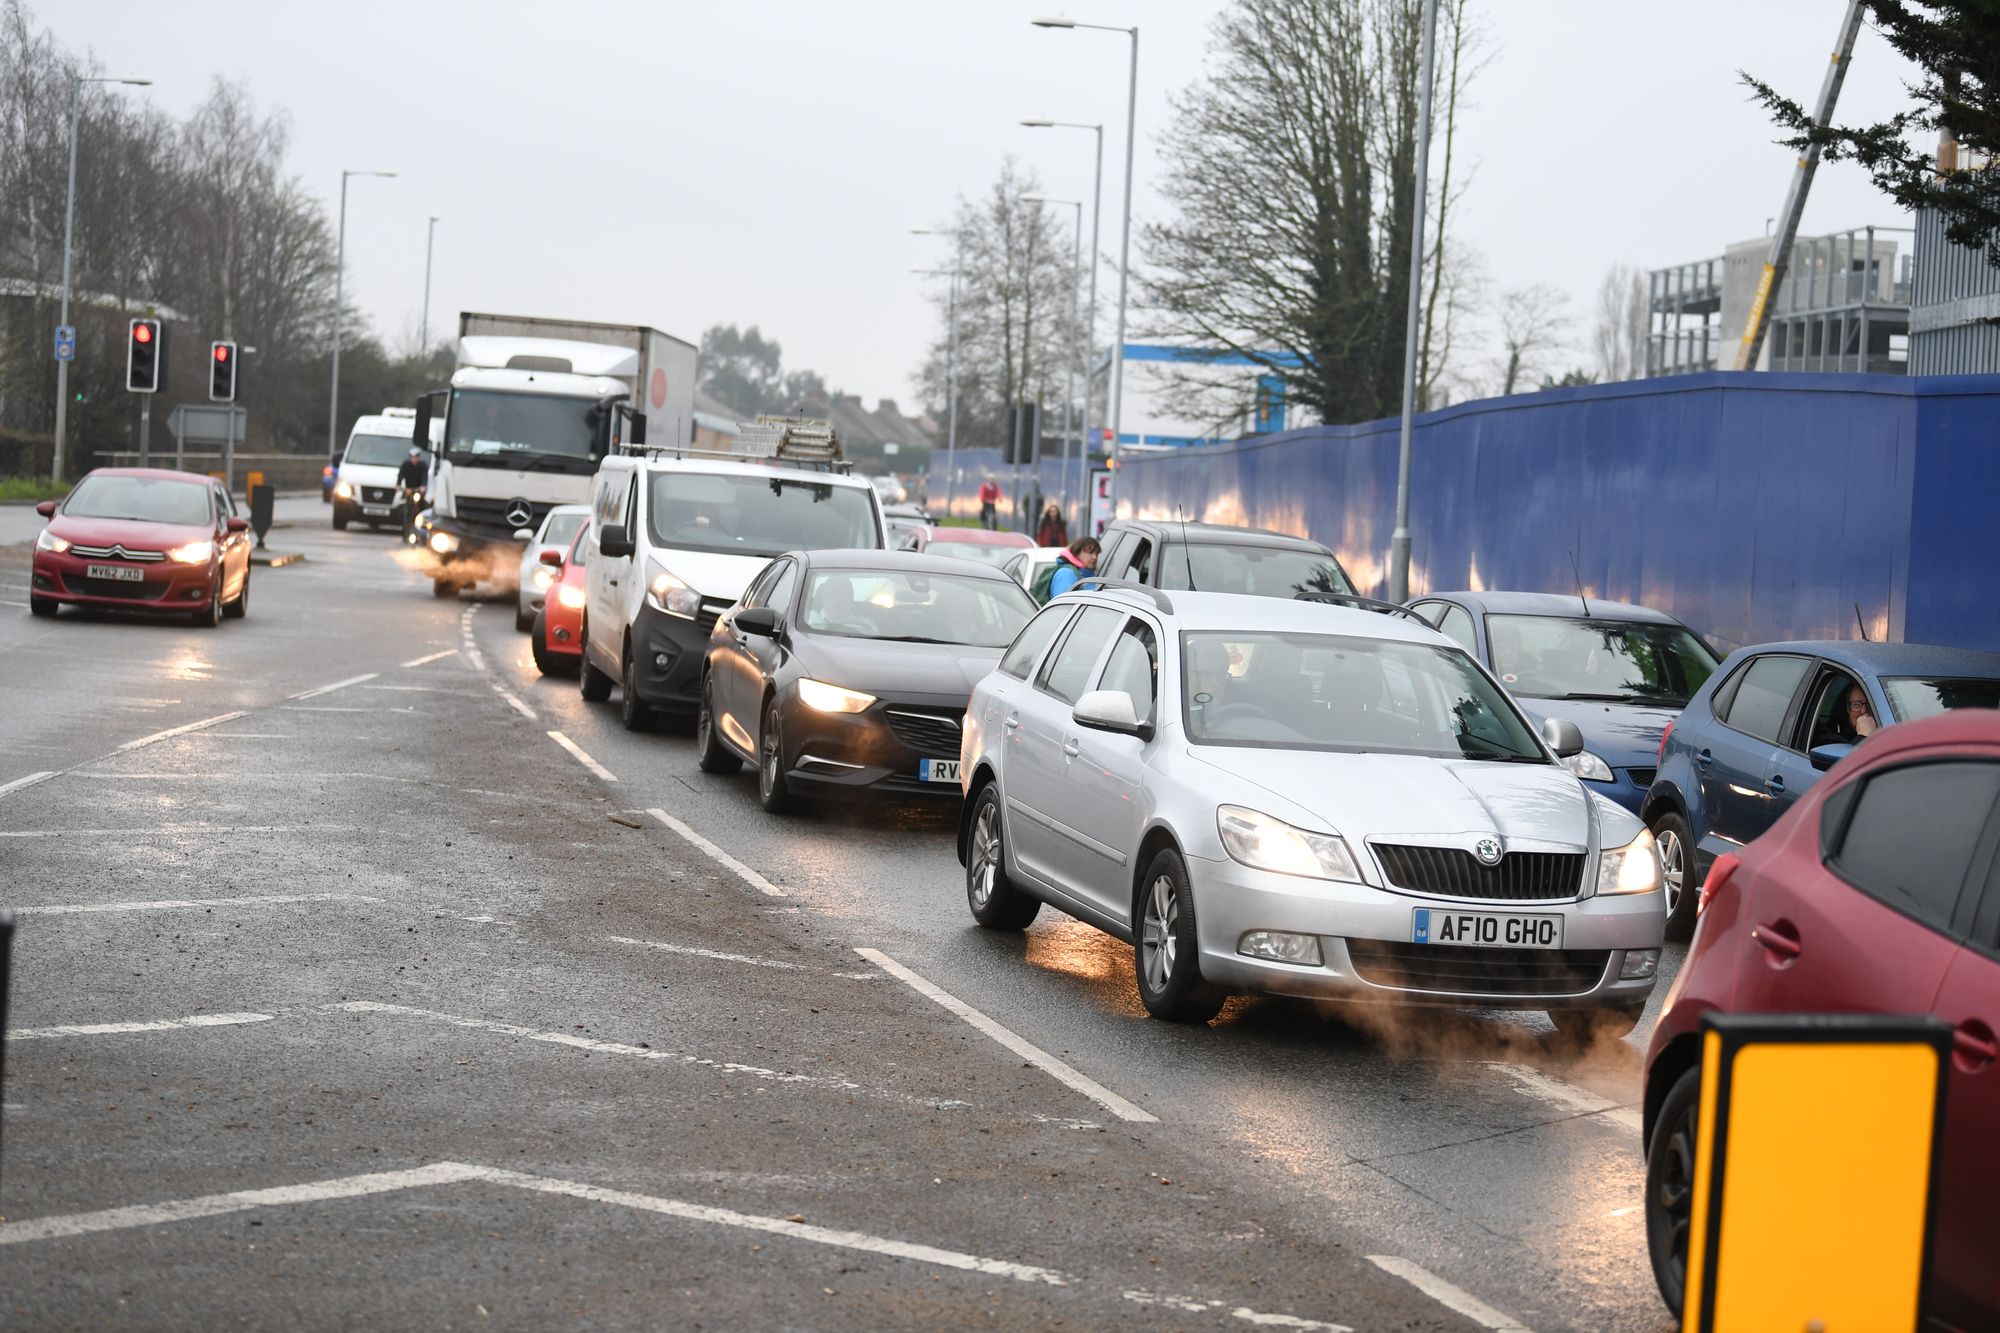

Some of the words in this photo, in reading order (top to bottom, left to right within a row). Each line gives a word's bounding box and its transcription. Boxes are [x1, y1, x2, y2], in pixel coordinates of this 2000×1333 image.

[935, 762, 961, 779] RV
[1439, 915, 1498, 943] AF10
[1505, 918, 1554, 945] GHO
